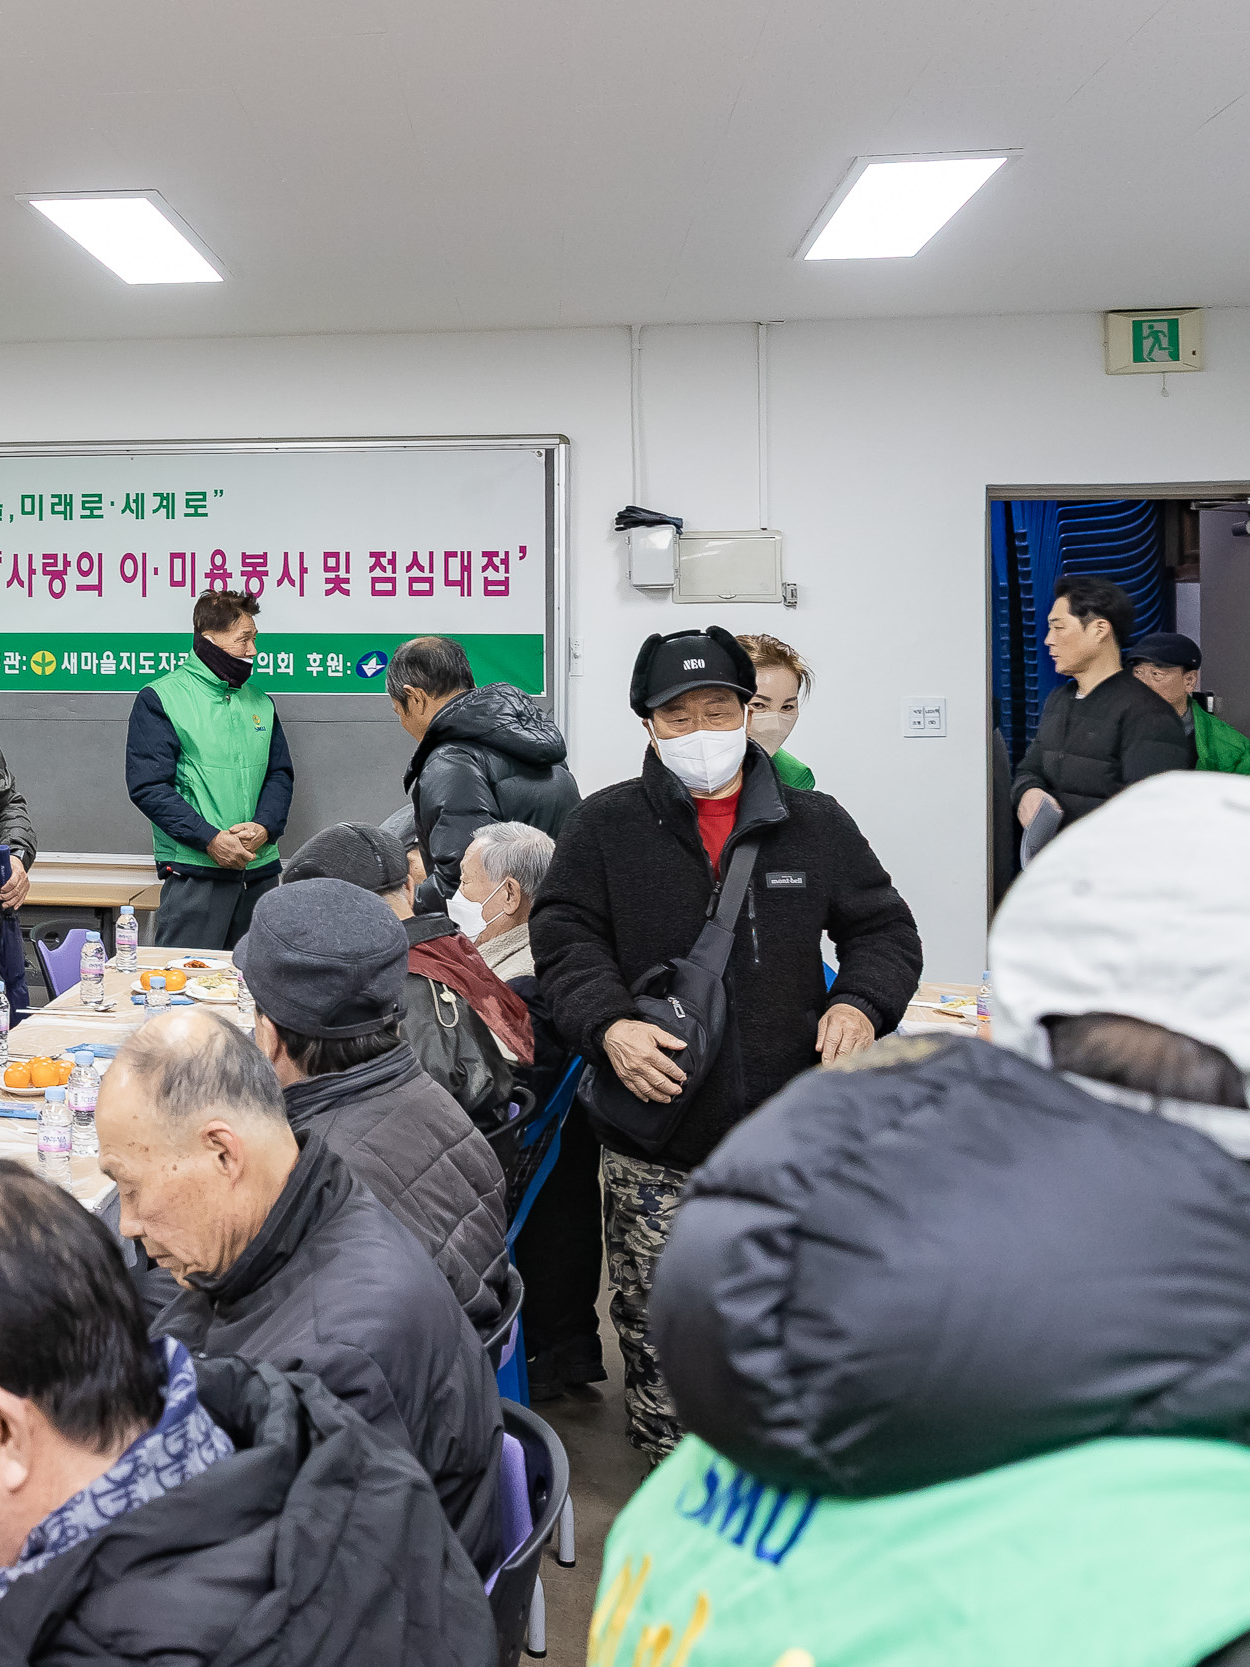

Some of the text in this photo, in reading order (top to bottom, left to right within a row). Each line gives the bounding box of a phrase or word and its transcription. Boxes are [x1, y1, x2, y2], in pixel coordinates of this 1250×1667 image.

[119, 548, 309, 599] 이·미용봉사
[323, 550, 352, 597] 및
[368, 545, 528, 598] 점심대접’
[306, 652, 352, 677] 후원:
[683, 659, 706, 670] NEO
